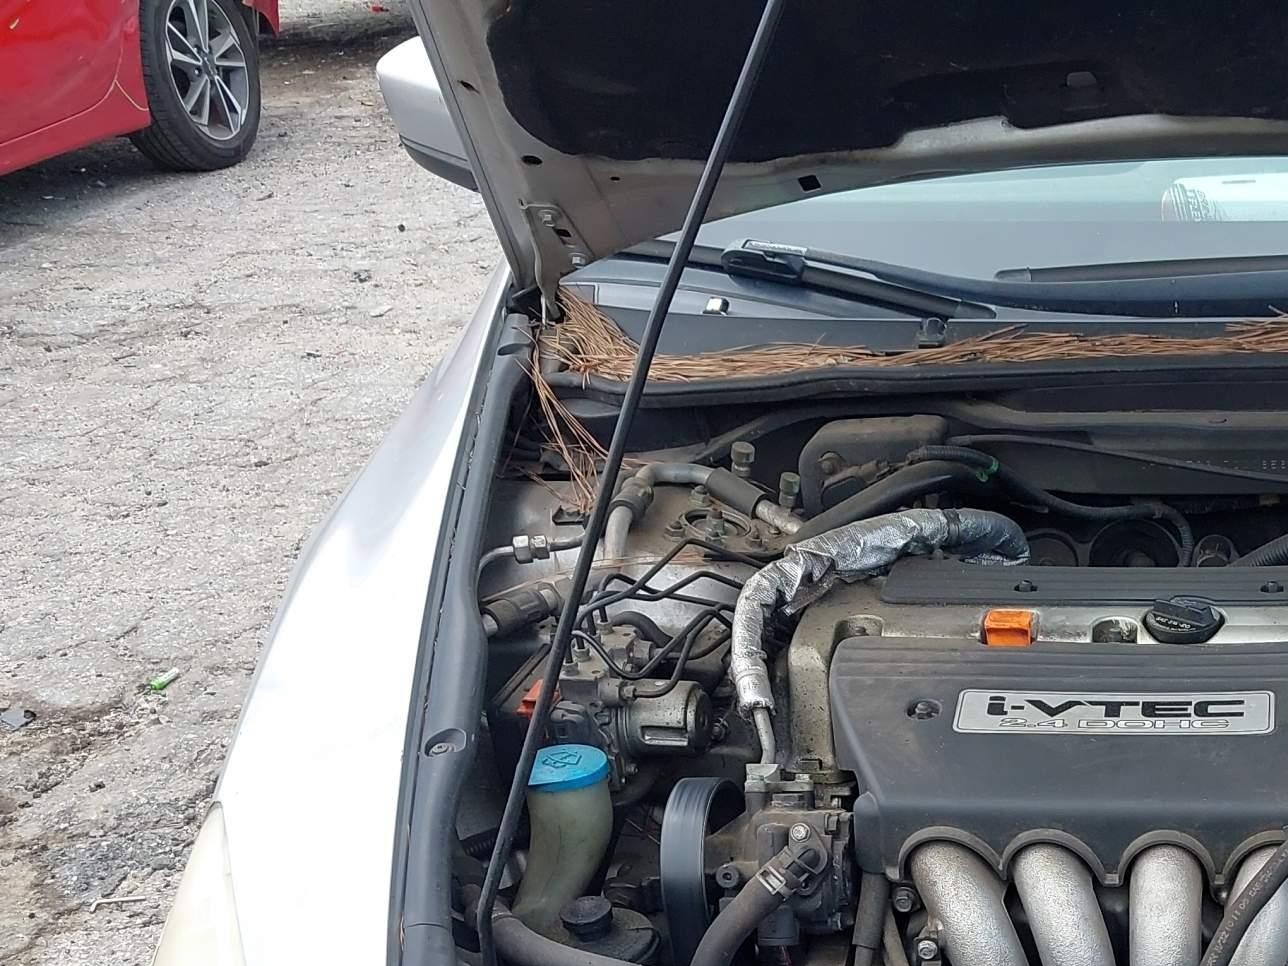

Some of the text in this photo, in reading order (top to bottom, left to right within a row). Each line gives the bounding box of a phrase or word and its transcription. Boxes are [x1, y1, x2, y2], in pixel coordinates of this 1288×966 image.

[986, 695, 1245, 718] i-VTEC
[999, 718, 1231, 729] 2.4 DOHC
